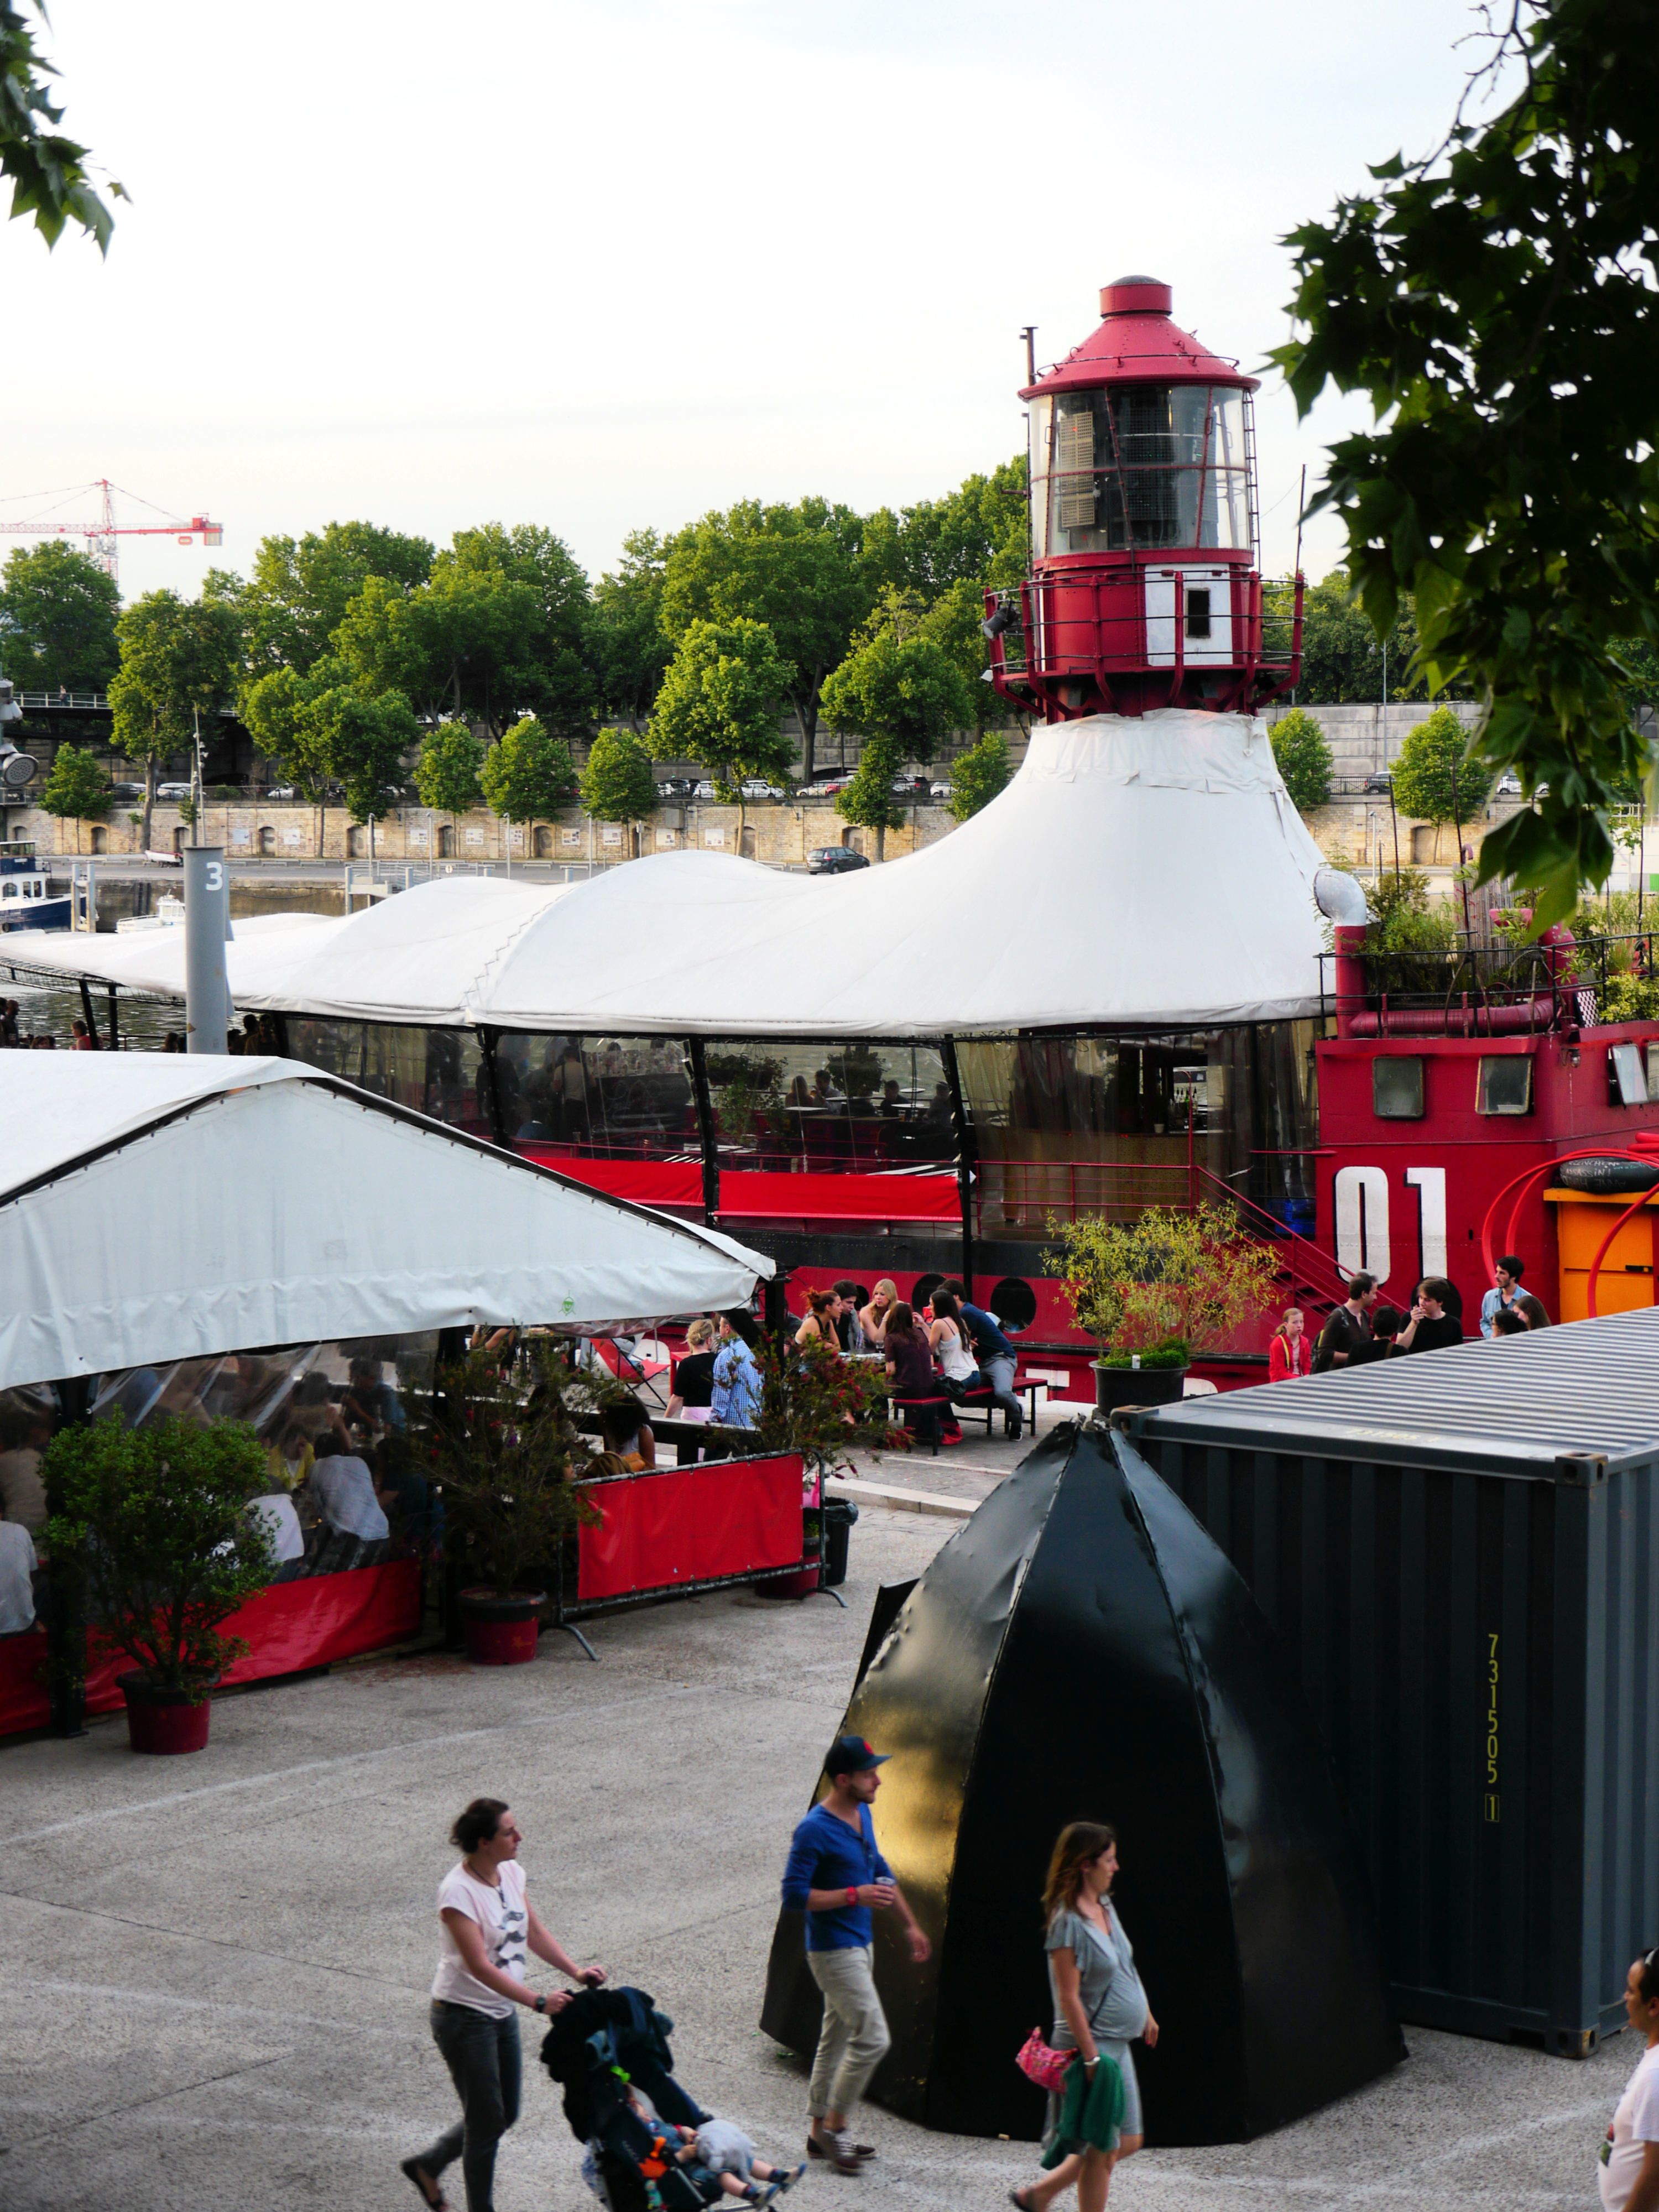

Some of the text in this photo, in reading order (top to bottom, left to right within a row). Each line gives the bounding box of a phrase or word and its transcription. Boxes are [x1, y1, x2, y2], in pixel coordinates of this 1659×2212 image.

[206, 862, 223, 891] 3
[1335, 1166, 1447, 1285] 01
[1488, 1634, 1499, 1784] 731505
